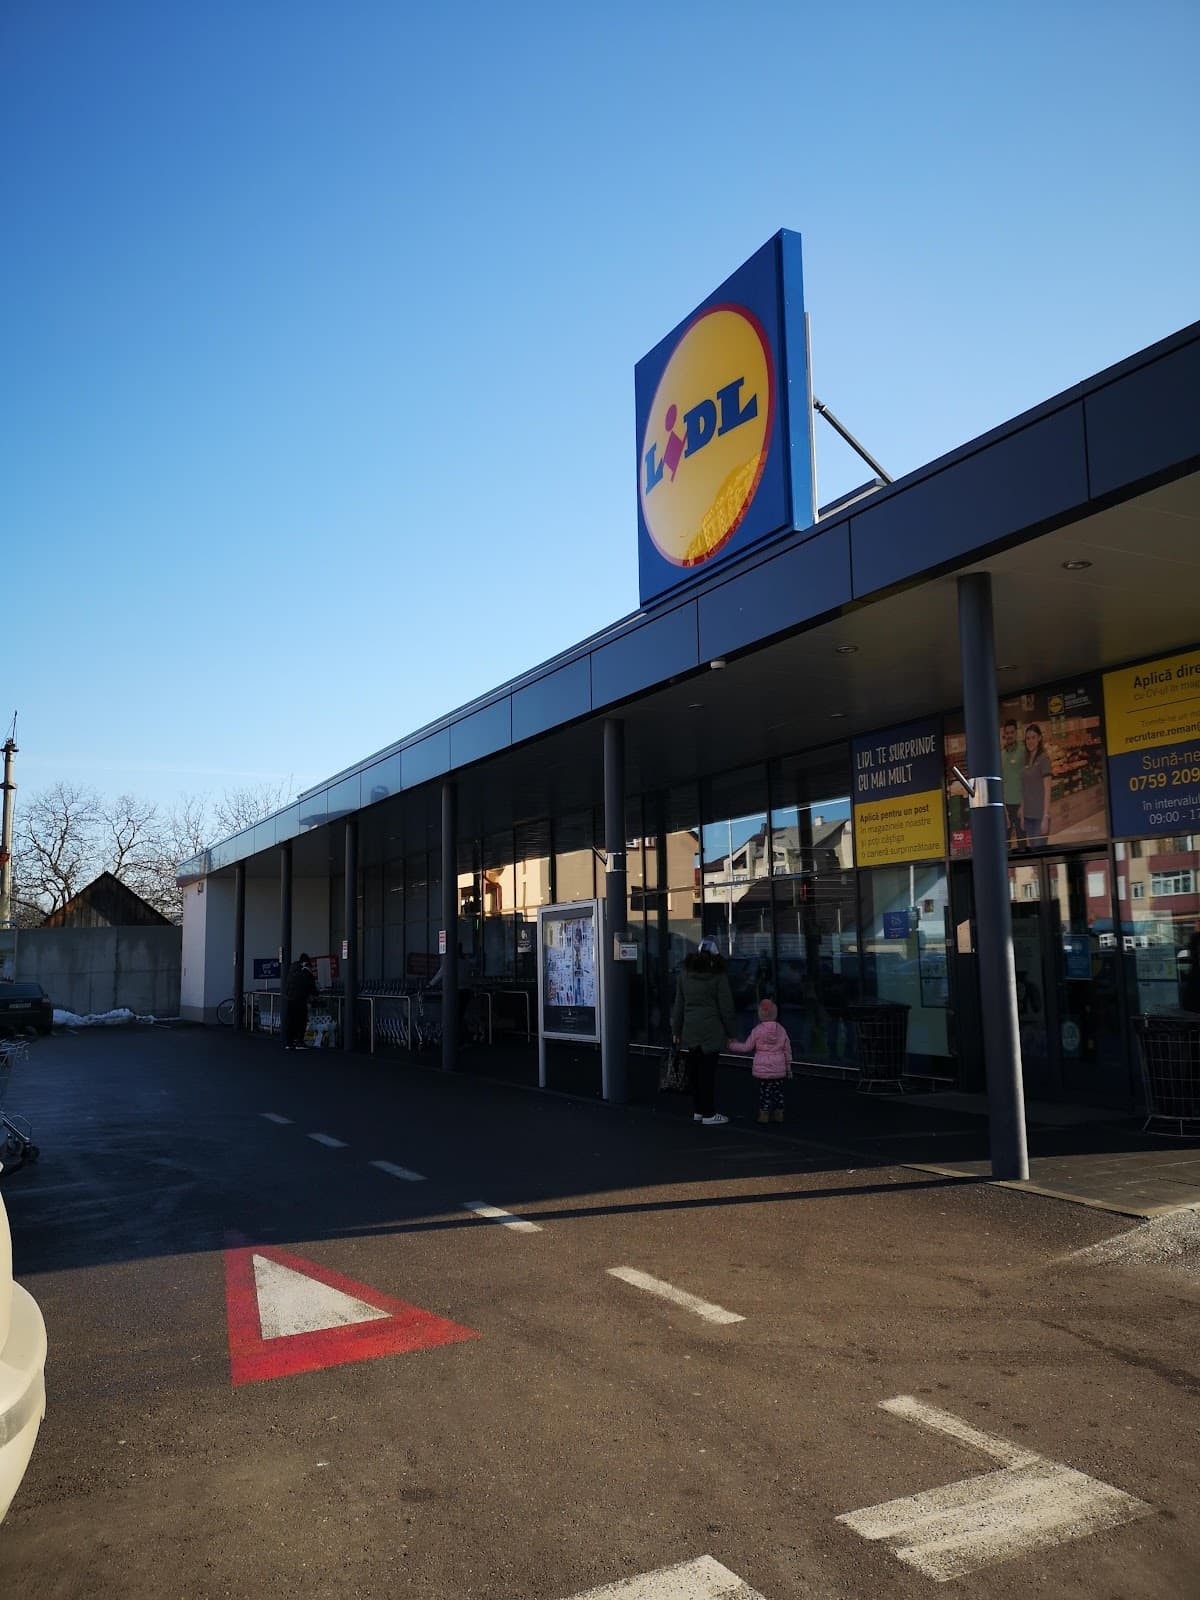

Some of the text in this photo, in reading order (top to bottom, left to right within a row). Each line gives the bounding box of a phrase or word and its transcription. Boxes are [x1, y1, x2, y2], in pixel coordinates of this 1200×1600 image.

[1133, 668, 1173, 689] Aplică
[857, 735, 936, 770] LIDL TE SURPRINDE
[858, 763, 913, 792] CU MAI MULT
[1128, 767, 1200, 792] 0759 209
[860, 803, 929, 824] Aplică pentru un post
[1149, 810, 1180, 825] 09:00
